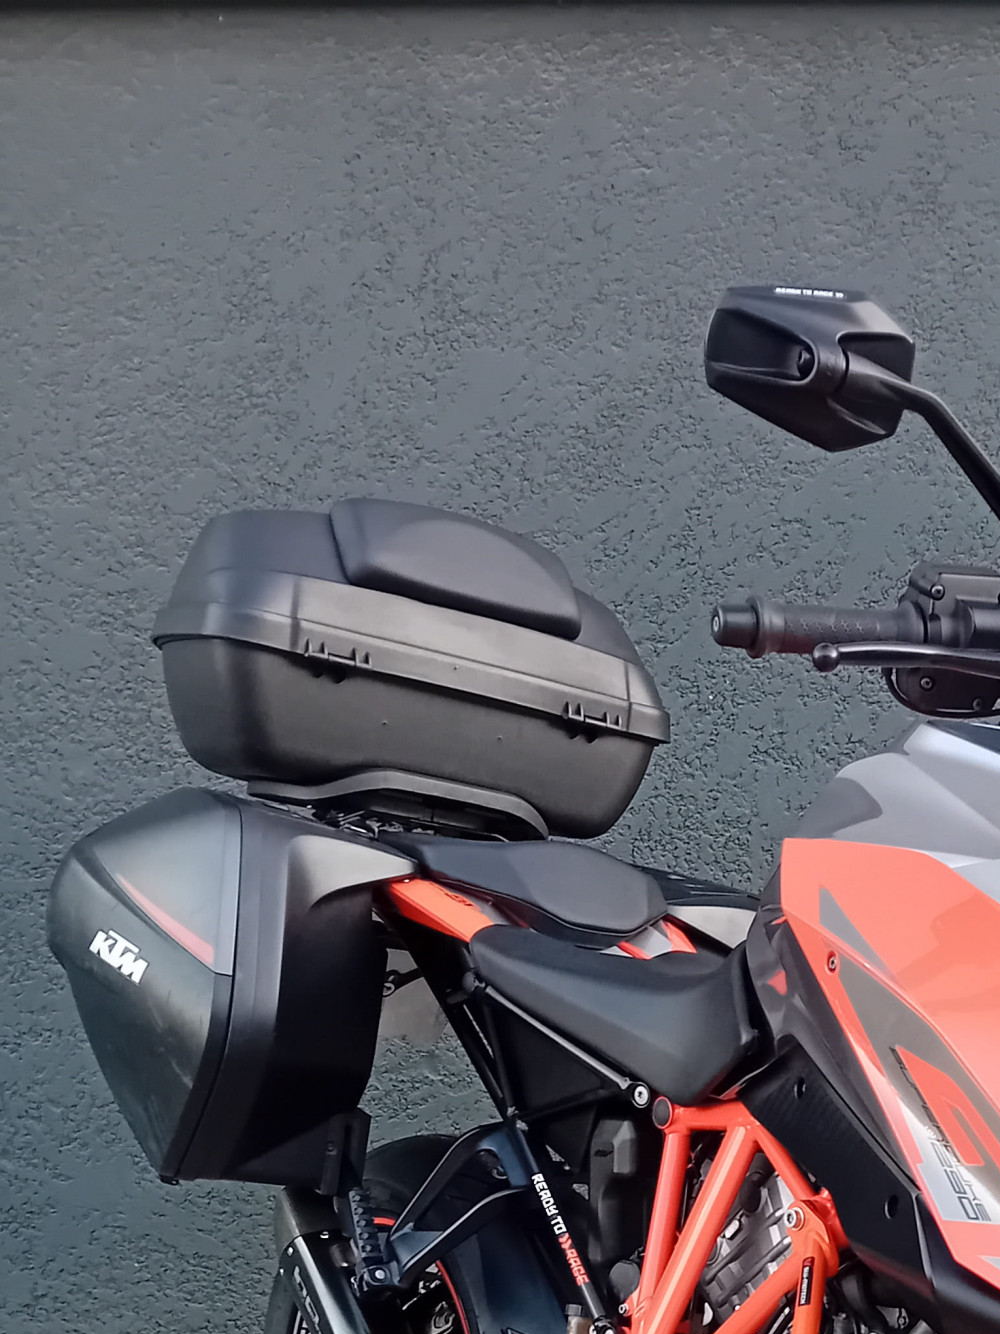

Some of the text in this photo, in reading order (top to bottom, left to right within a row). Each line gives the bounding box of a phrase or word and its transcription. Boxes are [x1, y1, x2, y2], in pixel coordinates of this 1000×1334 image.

[88, 929, 149, 985] KTM
[531, 1172, 590, 1287] READY TO RACE
